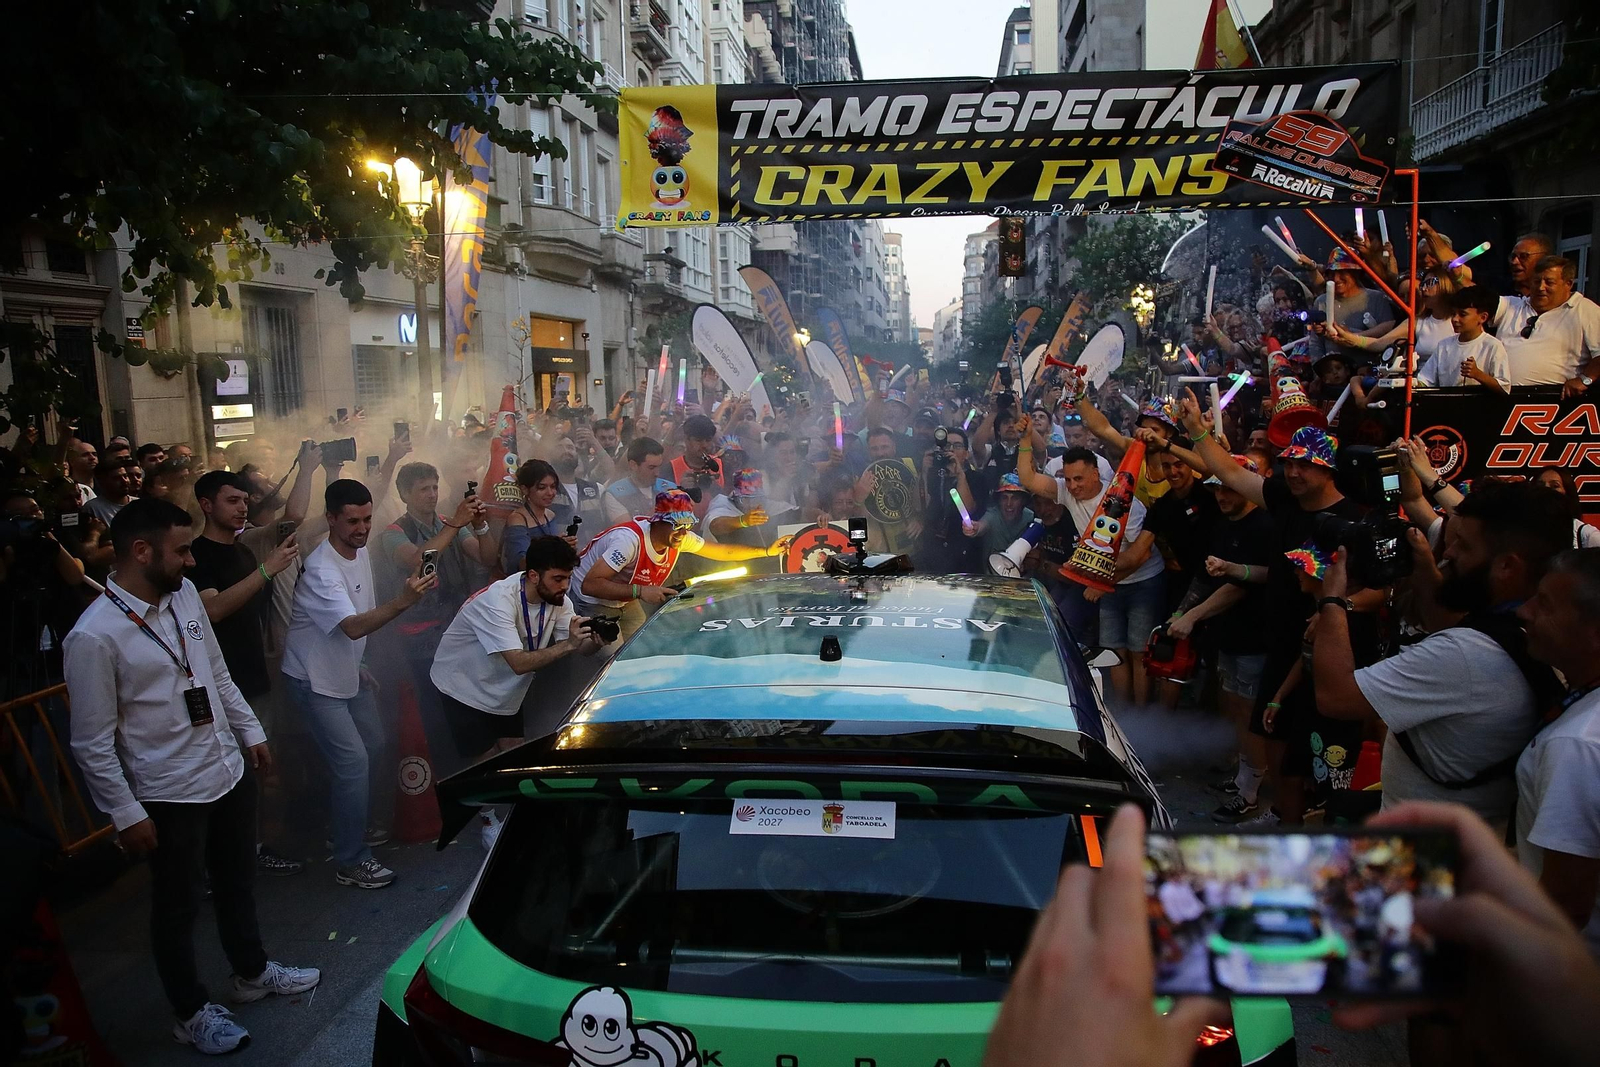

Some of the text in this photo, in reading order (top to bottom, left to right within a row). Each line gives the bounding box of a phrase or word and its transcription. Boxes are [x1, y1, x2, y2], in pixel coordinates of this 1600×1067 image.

[729, 73, 1361, 140] TRAMO ESPECTÁCULO
[1265, 114, 1348, 157] 59
[1225, 130, 1296, 160] RALLYE
[1294, 153, 1382, 185] OURENSE
[753, 159, 1015, 207] CRAZY
[1032, 153, 1231, 203] FANS
[1264, 167, 1322, 197] Recalvi
[628, 210, 711, 222] CRAZY FANS
[1277, 398, 1296, 410] CRAZY
[1440, 447, 1457, 474] OURENSE
[1075, 550, 1113, 572] CRAZY FANS
[698, 615, 1007, 632] ASTURIAS
[758, 818, 783, 827] 2027
[759, 806, 811, 816] Xacobeo
